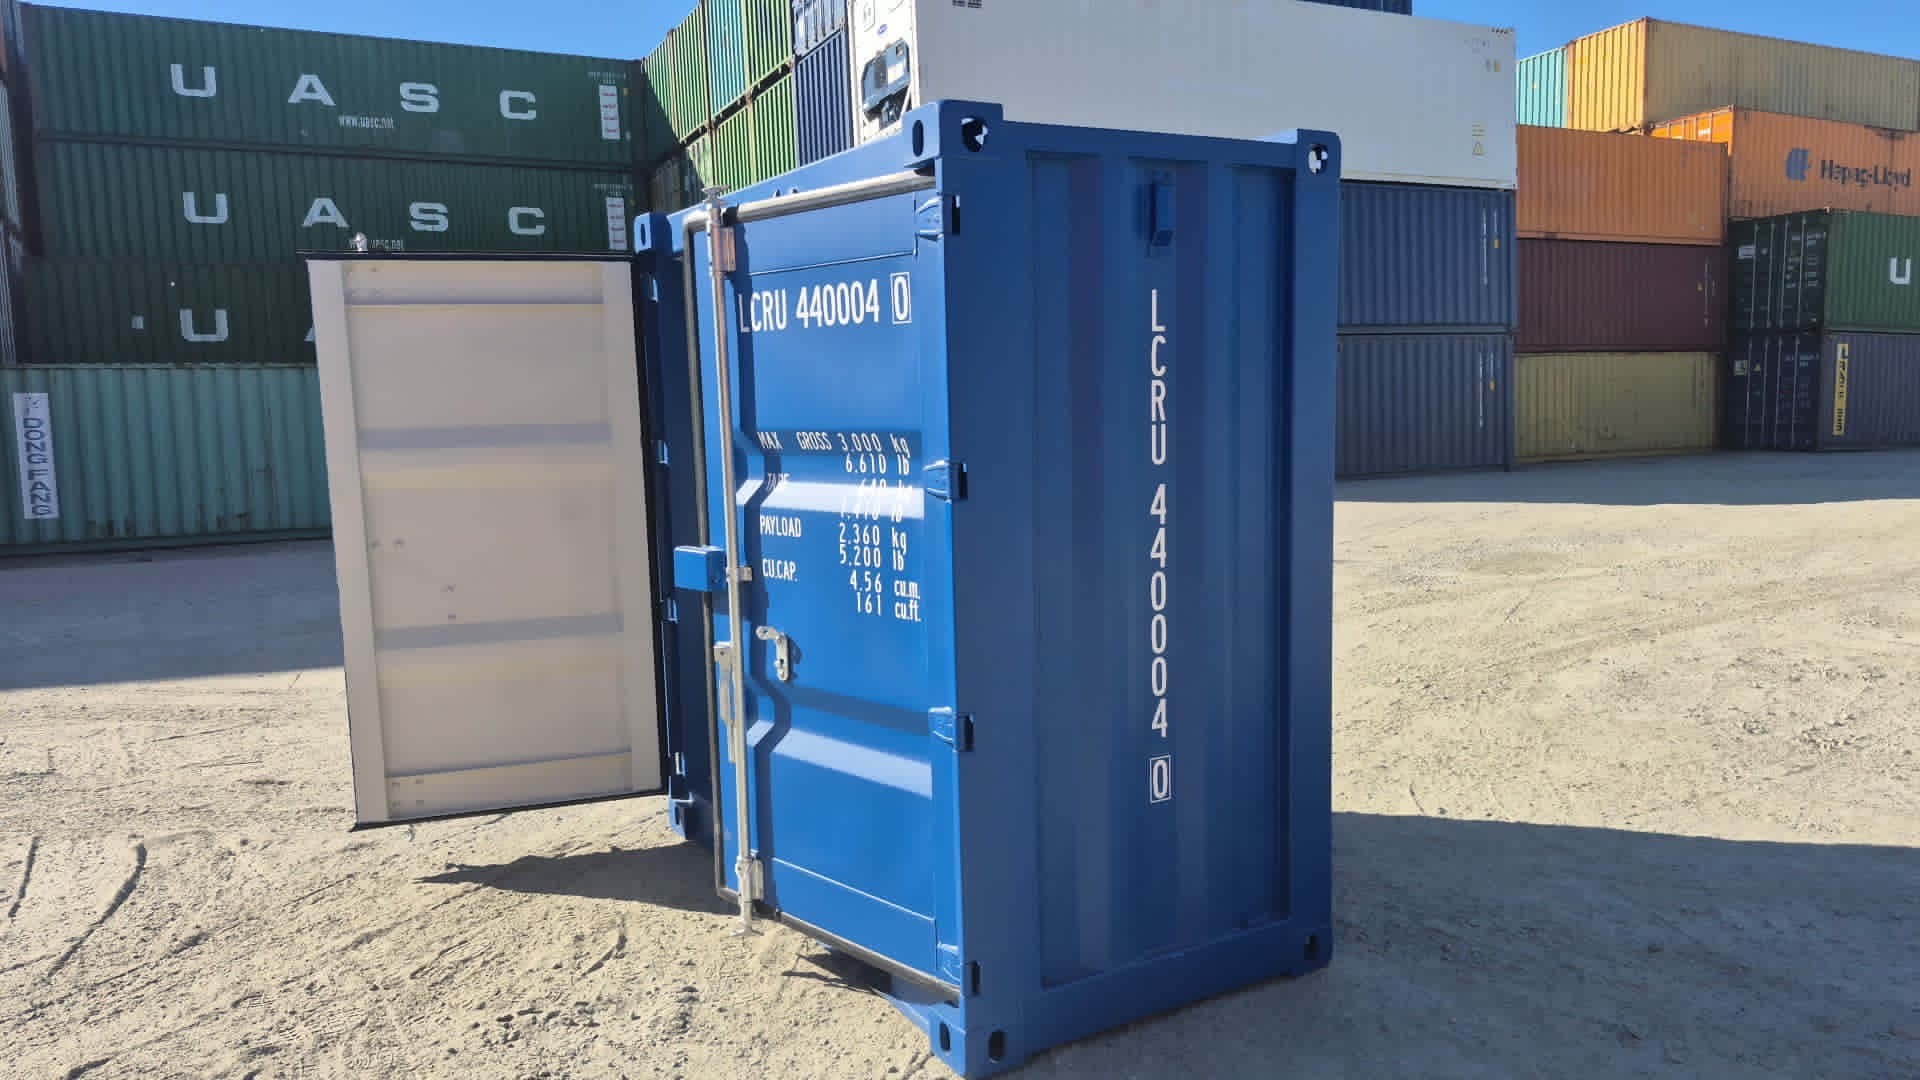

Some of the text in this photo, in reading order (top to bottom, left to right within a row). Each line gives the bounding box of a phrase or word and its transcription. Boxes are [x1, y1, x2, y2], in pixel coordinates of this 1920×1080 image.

[1819, 158, 1912, 192] Hapag-Lloyd
[738, 273, 911, 334] LCRU 440004 0
[757, 431, 783, 450] MAX
[796, 431, 832, 451] GROSS
[890, 433, 911, 459] kg
[896, 454, 910, 476] lb
[759, 514, 907, 555] PAYLOAD 2.360 kg
[1150, 288, 1170, 801] LCRU 440004 0
[839, 543, 905, 571] 5.200 lb
[850, 569, 882, 593] 4.56
[856, 591, 882, 616] 161
